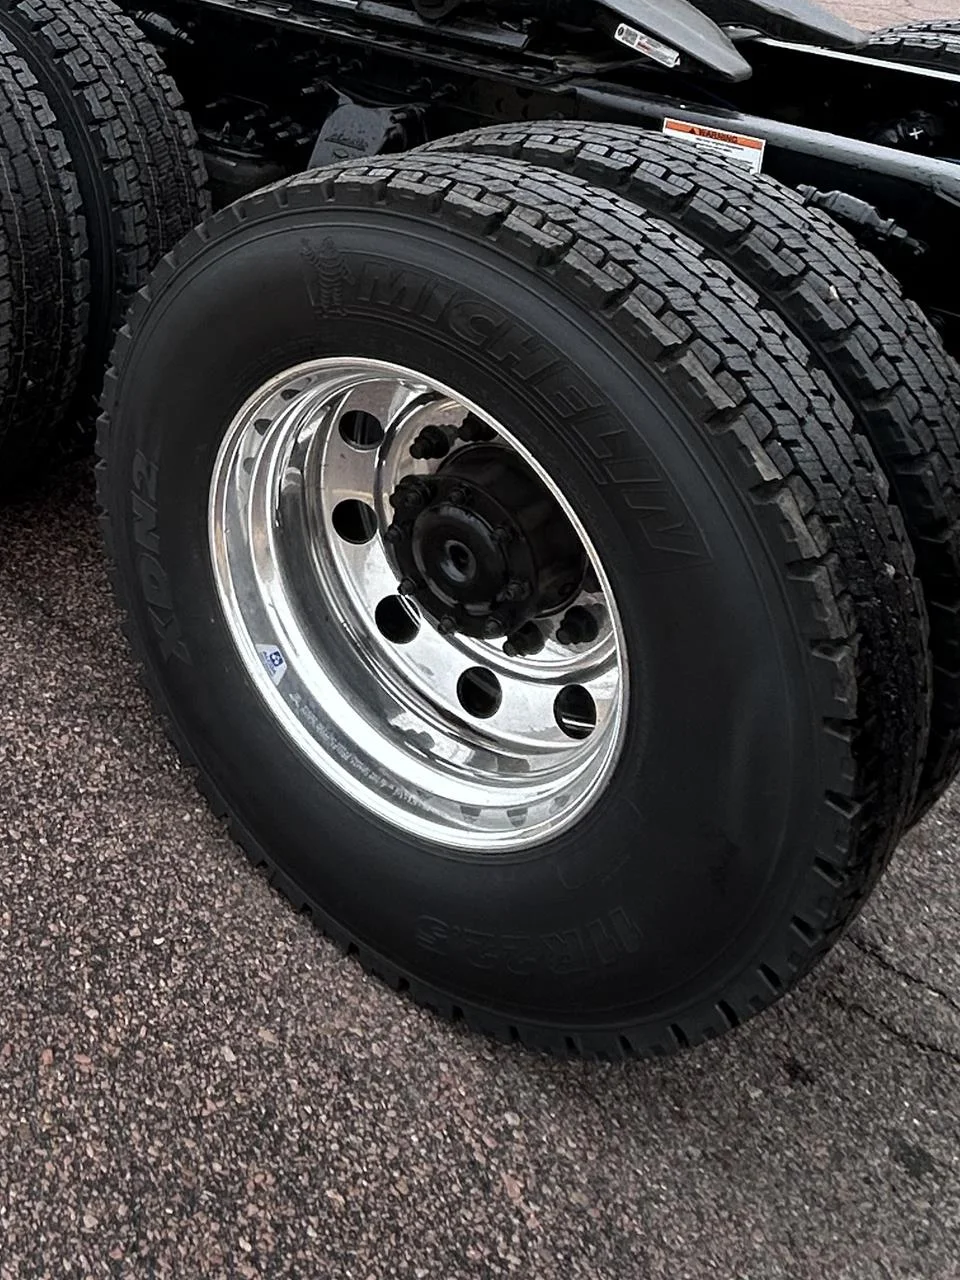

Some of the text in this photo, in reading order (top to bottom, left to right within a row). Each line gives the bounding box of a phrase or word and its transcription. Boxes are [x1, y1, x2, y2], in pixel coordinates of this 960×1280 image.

[698, 127, 739, 144] WARNING
[357, 260, 702, 558] MICHELIN
[130, 447, 194, 666] XDN2
